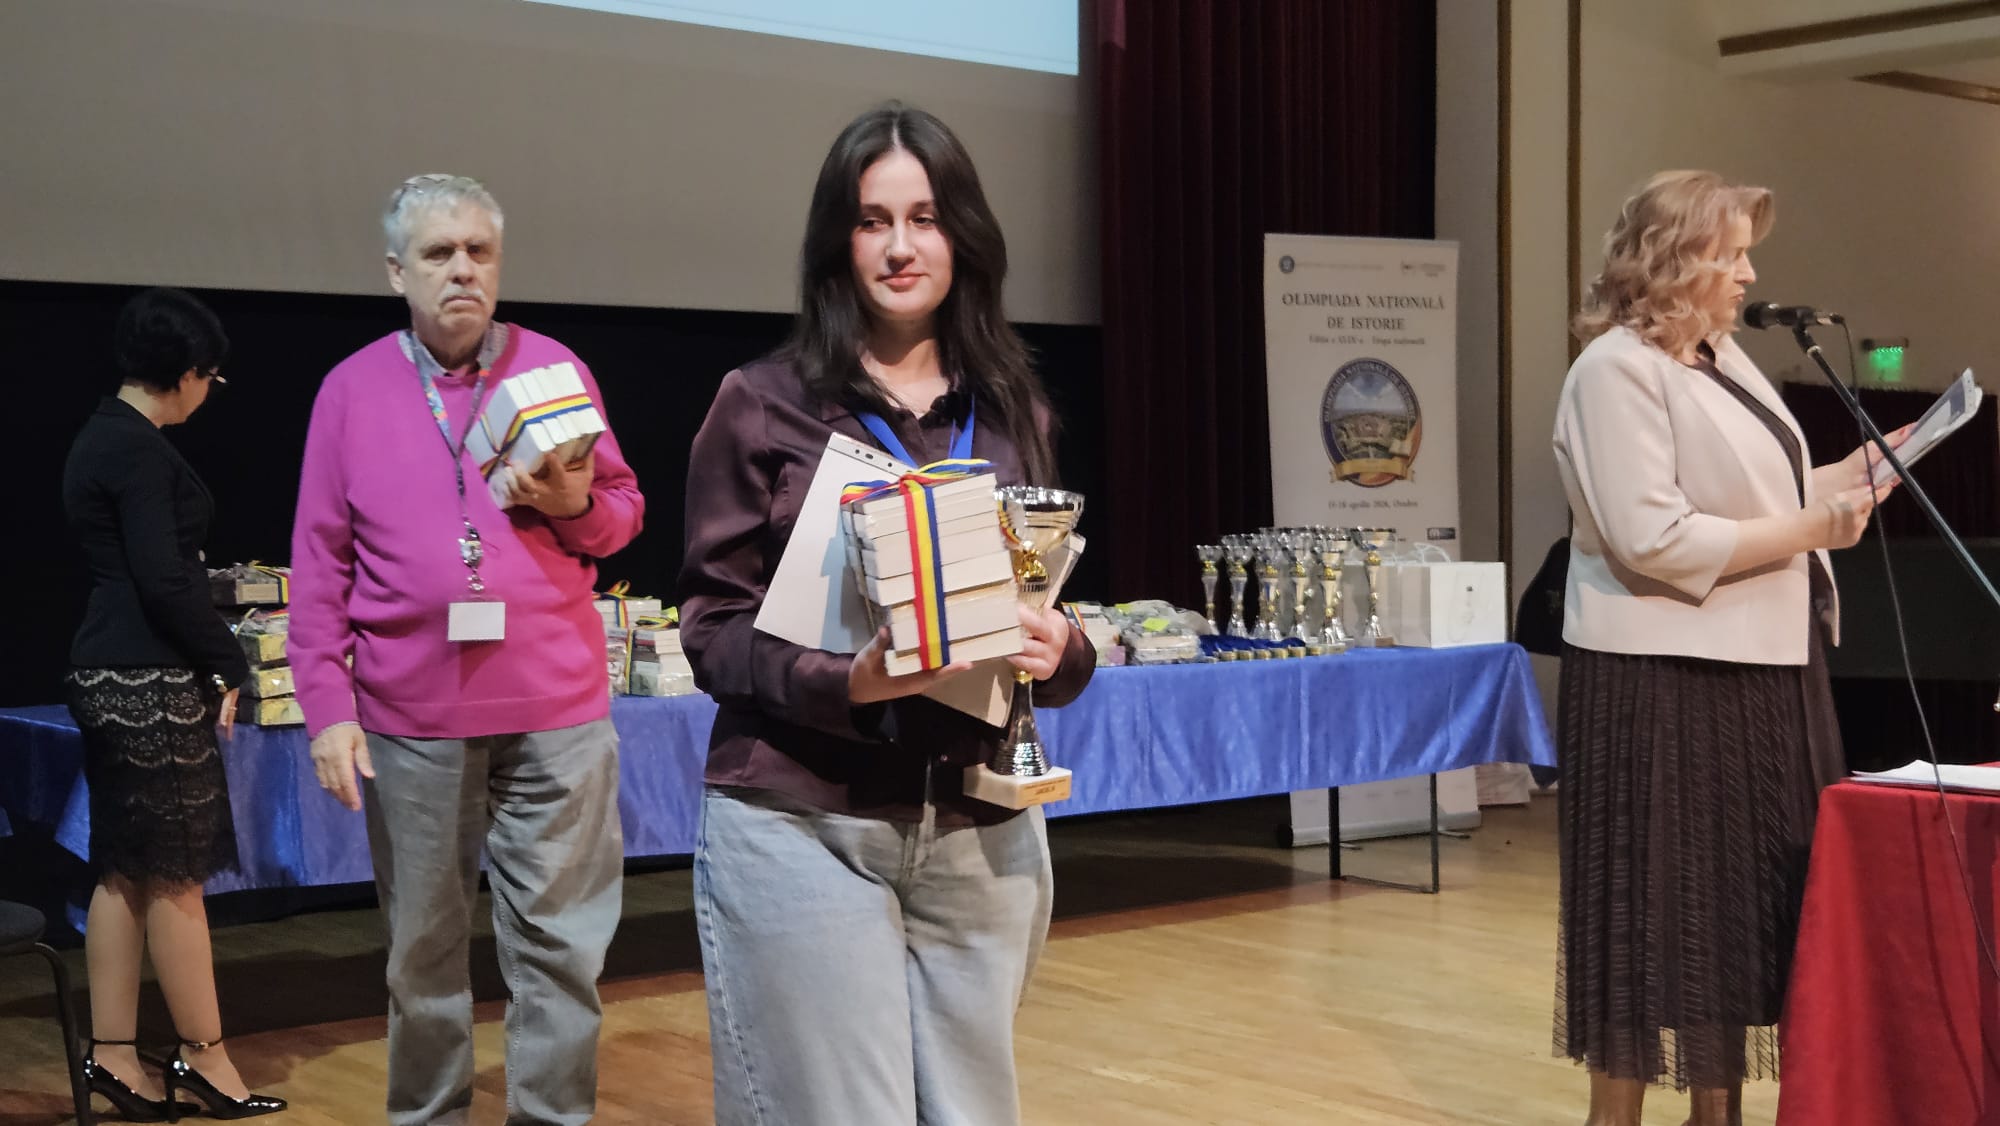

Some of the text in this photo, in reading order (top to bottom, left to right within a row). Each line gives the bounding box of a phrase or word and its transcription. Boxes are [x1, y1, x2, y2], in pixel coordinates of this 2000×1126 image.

[1282, 293, 1360, 306] OLIMPIADA
[1327, 316, 1405, 330] DE ISTORIE
